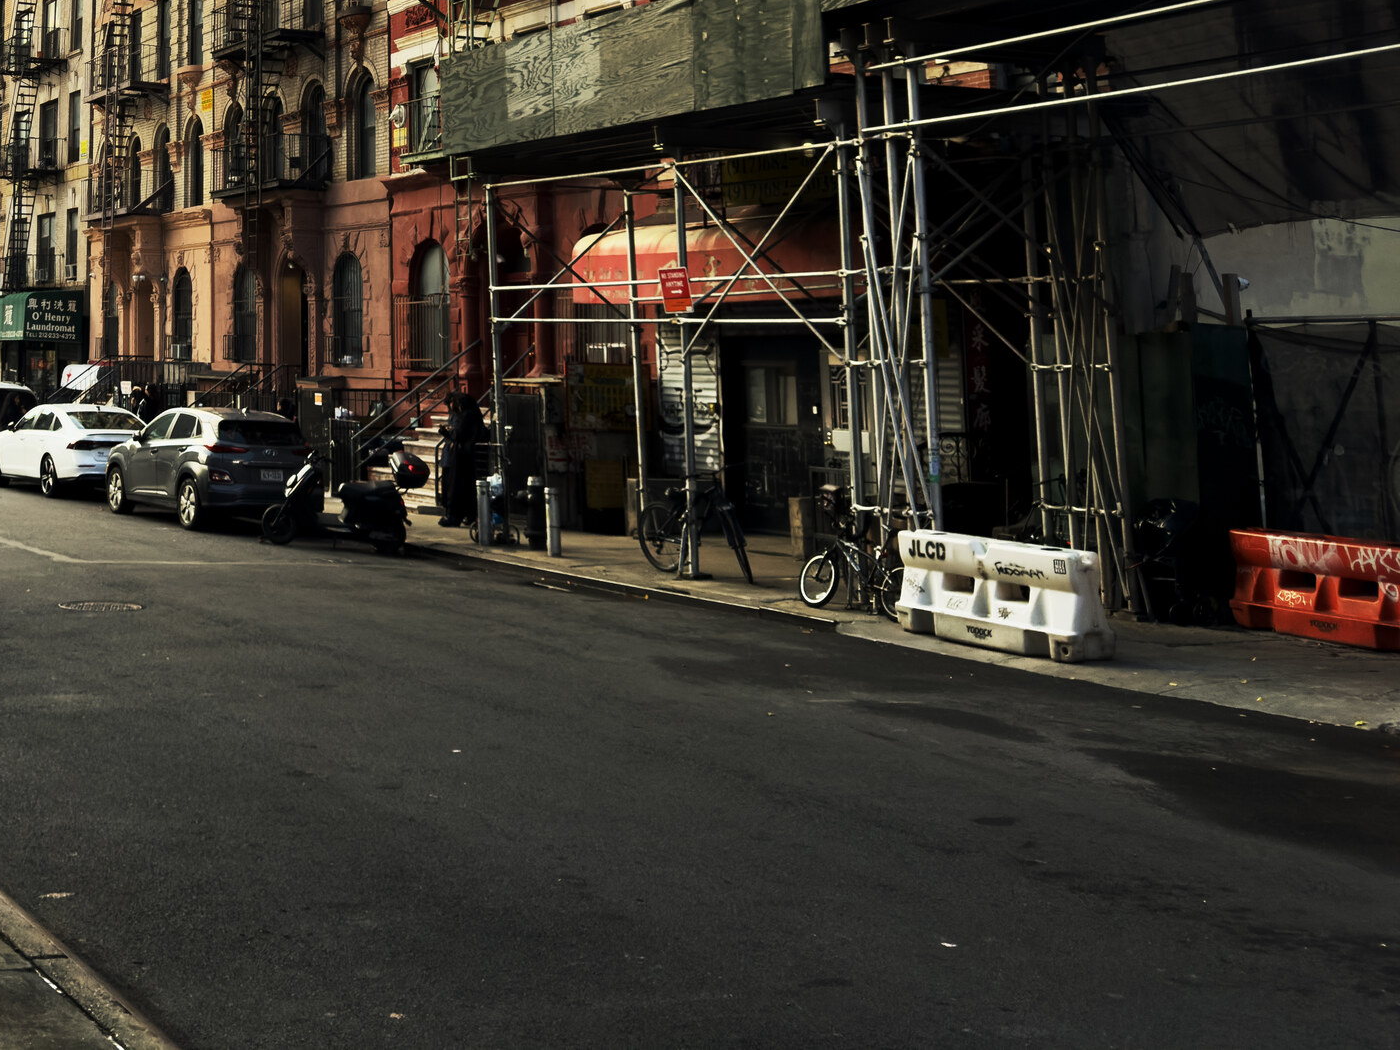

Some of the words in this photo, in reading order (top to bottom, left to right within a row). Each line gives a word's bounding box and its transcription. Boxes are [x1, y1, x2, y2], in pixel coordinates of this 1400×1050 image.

[44, 312, 71, 324] Henry
[26, 321, 76, 333] Laundromat
[908, 539, 947, 561] JLCD
